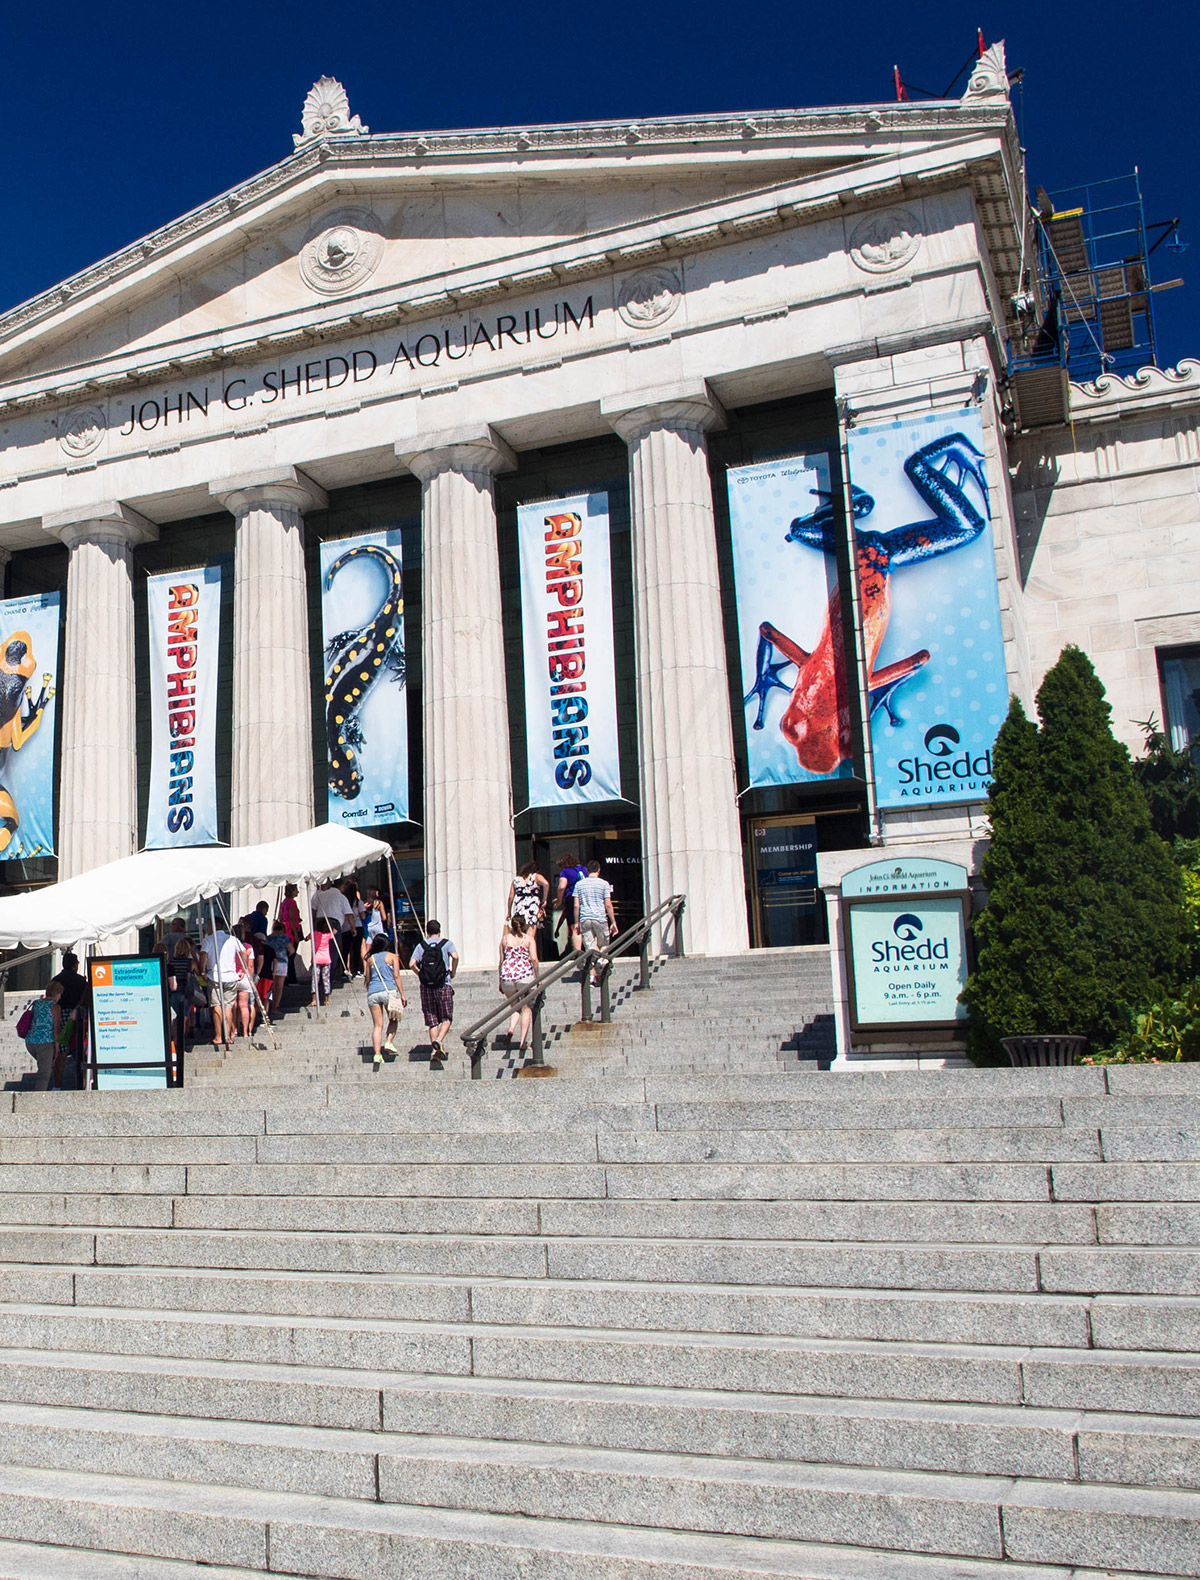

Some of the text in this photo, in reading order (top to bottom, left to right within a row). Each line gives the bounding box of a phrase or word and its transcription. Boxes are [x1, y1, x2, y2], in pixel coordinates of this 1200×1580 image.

[120, 295, 594, 436] JOHN G. SHEDD AQUARIUM
[749, 473, 776, 481] TOYOTA
[543, 511, 593, 790] AMPHIBIANS
[167, 583, 200, 834] AMPHIBIANS
[897, 749, 992, 784] Shedd
[342, 809, 368, 818] ComEd
[760, 843, 813, 854] MEMBERSHIP
[908, 871, 937, 881] Aquarium
[859, 880, 949, 893] INFORMATION
[871, 937, 949, 962] Shedd
[114, 967, 148, 975] Extraordinary
[873, 963, 949, 973] AQUARIUM
[115, 974, 144, 982] Experiences
[888, 981, 936, 991] Open Daily
[923, 991, 942, 999] p.m.
